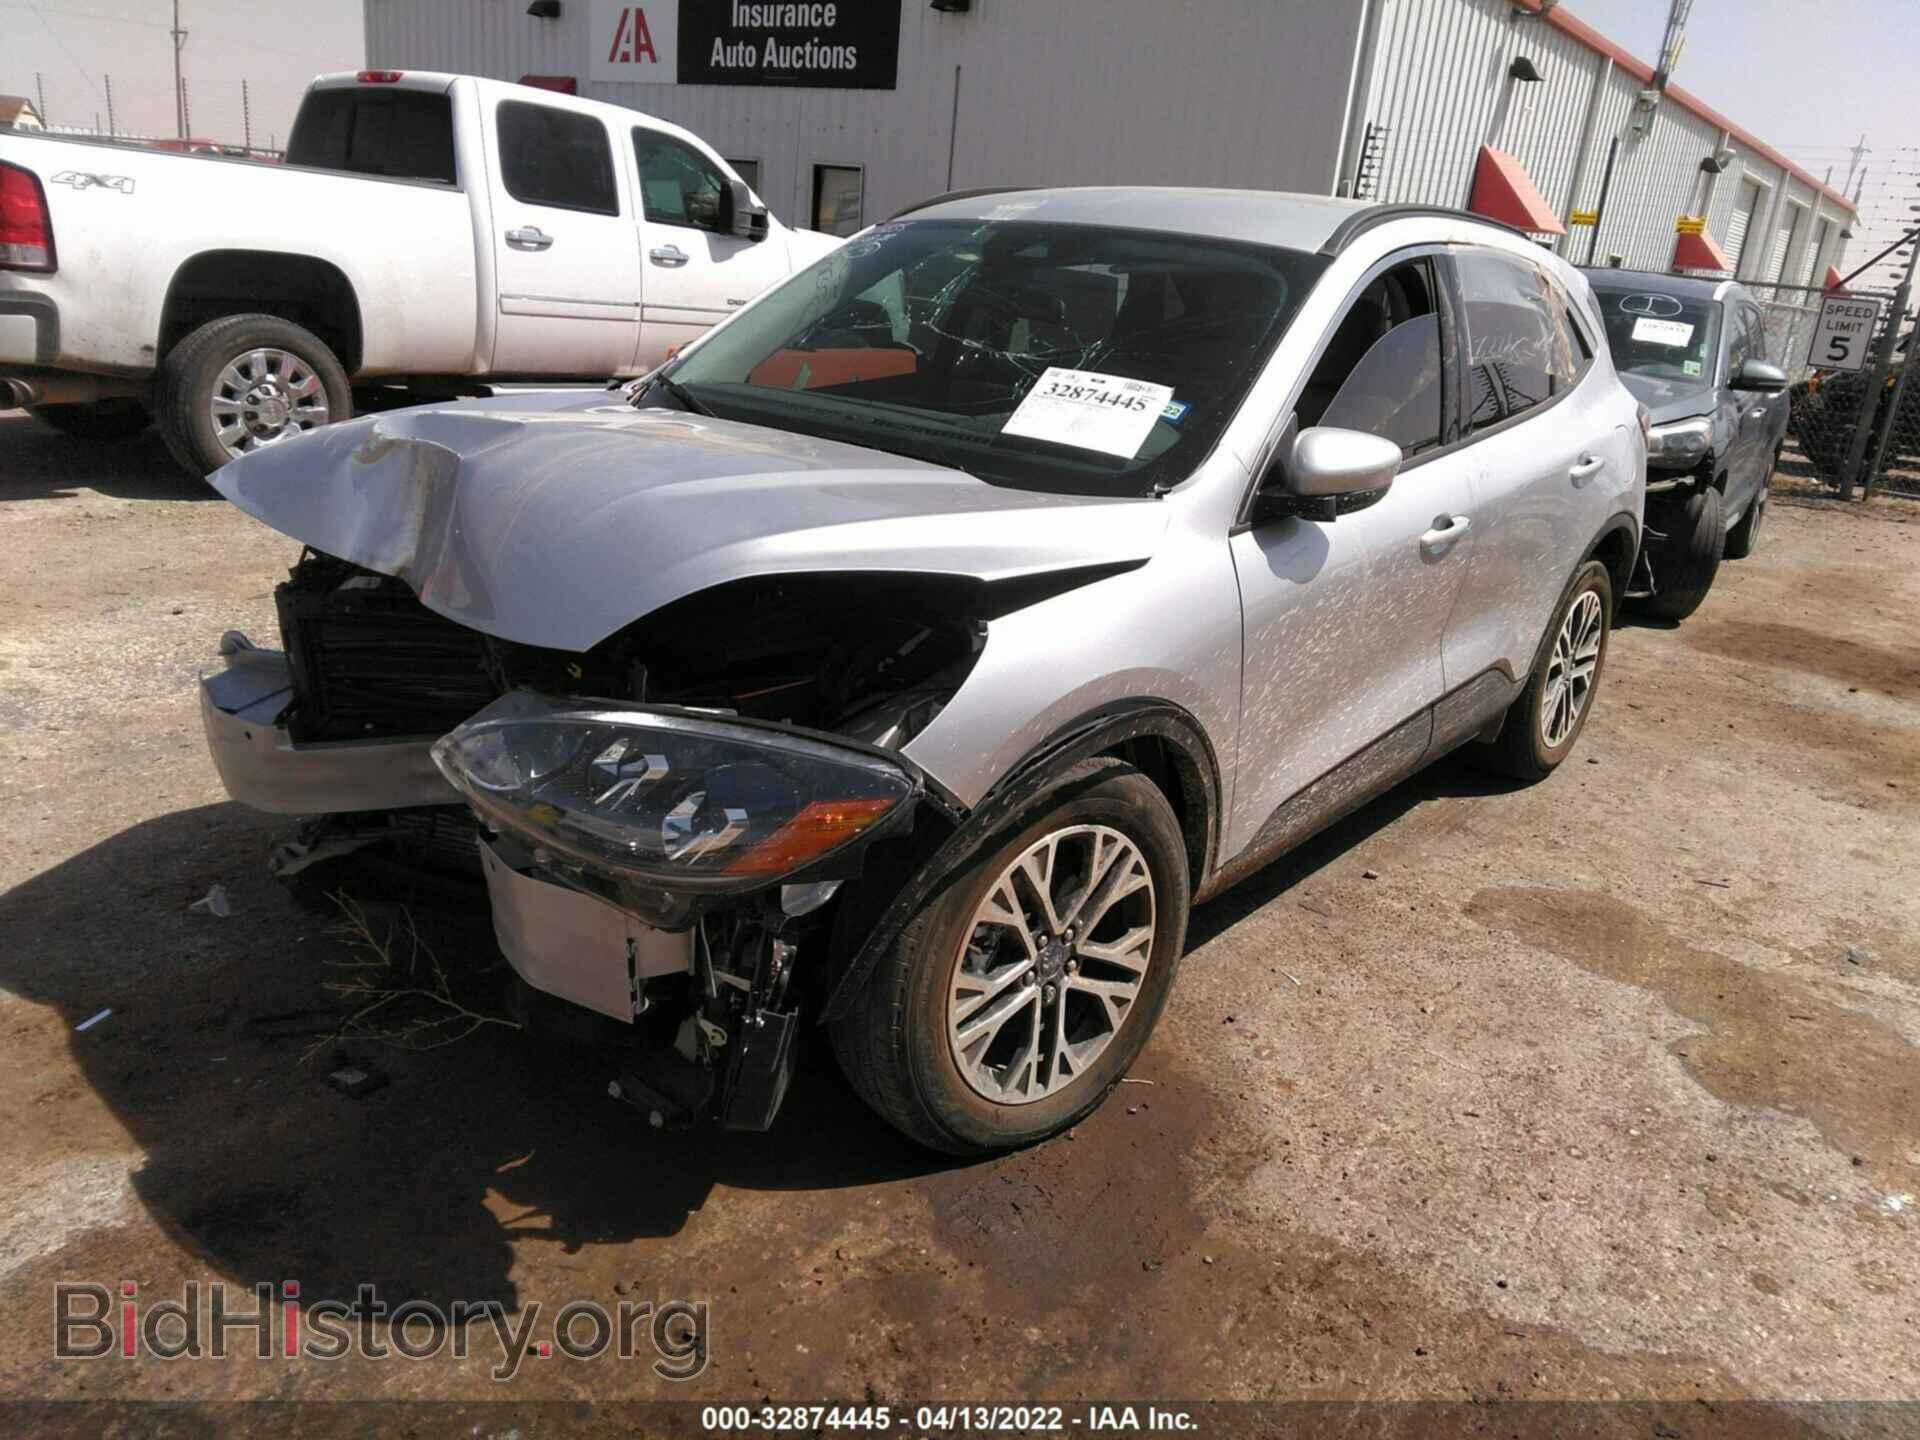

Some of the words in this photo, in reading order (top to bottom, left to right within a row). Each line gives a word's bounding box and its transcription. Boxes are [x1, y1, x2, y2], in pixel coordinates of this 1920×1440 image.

[732, 0, 837, 28] Insurance
[710, 36, 758, 68] Auto
[762, 36, 857, 70] Auctions
[1825, 304, 1873, 319] SPEED
[1826, 320, 1865, 333] LIMIT
[1826, 335, 1851, 362] 5
[1042, 381, 1147, 413] 32874445
